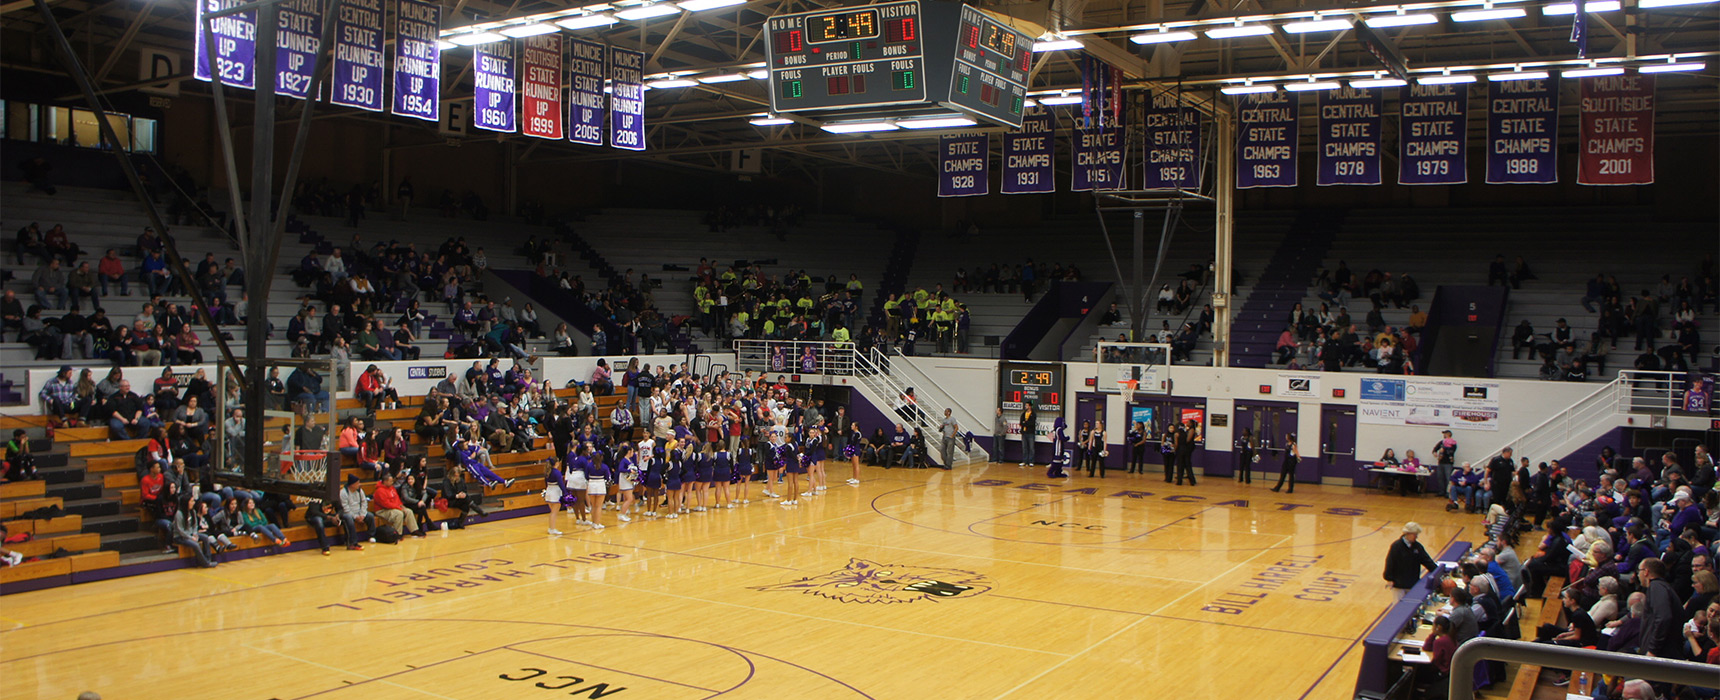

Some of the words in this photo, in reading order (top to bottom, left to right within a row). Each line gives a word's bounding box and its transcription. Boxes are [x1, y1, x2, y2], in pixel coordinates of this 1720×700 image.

[340, 5, 382, 30] CENTRAL
[401, 1, 437, 24] MUNCIE
[880, 4, 917, 20] VISITOR
[963, 8, 981, 26] HOME
[279, 11, 314, 34] STATE
[400, 19, 436, 41] CENTRAL
[772, 17, 802, 31] HOME
[823, 12, 874, 39] 2:49
[902, 18, 914, 41] 0
[344, 25, 377, 48] STATE
[528, 35, 558, 53] MUNCIE
[790, 30, 802, 52] 0
[970, 26, 979, 49] 0
[988, 25, 1015, 55] 2:49
[219, 37, 236, 57] UP
[404, 39, 434, 60] STATE
[574, 43, 602, 62] MUNCIE
[882, 45, 908, 56] BONUS
[289, 52, 304, 71] UP
[337, 43, 383, 68] RUNNER
[525, 49, 559, 69] SOUTHSIDE
[615, 52, 641, 69] MUNCIE
[784, 54, 807, 66] BONUS
[825, 50, 849, 62] PERIOD
[963, 49, 977, 63] BONUS
[1022, 51, 1031, 72] 0
[151, 54, 173, 88] D
[217, 57, 245, 81] 923
[397, 56, 438, 79] RUNNER
[481, 58, 507, 75] STATE
[572, 59, 602, 78] CENTRAL
[822, 66, 848, 77] PLAYER
[852, 63, 874, 74] FOULS
[890, 59, 915, 70] FOULS
[958, 63, 971, 76] FOULS
[279, 71, 312, 93] 1927
[352, 65, 367, 83] UP
[529, 67, 555, 84] STATE
[613, 67, 642, 85] CENTRAL
[780, 70, 802, 80] FOULS
[903, 71, 914, 89] 0
[980, 72, 994, 85] PLAYER
[994, 78, 1007, 90] FOULS
[411, 77, 423, 94] UP
[475, 72, 513, 94] RUNNER
[575, 77, 599, 93] STATE
[792, 81, 802, 98] 0
[962, 76, 969, 94] 0
[1012, 85, 1024, 97] FOULS
[1410, 83, 1456, 97] MUNCIE
[1500, 80, 1547, 94] MUNCIE
[1593, 75, 1642, 92] MUNCIE
[343, 84, 374, 105] 1930
[526, 82, 559, 102] RUNNER
[615, 83, 639, 100] STATE
[1329, 86, 1371, 100] MUNCIE
[403, 94, 432, 115] 1954
[488, 93, 501, 108] UP
[572, 91, 604, 109] RUNNER
[1015, 98, 1022, 113] 0
[1492, 97, 1555, 114] CENTRAL
[1581, 95, 1653, 113] SOUTHSIDE
[536, 102, 549, 116] UP
[582, 109, 593, 123] UP
[1242, 108, 1294, 123] CENTRAL
[1322, 105, 1379, 119] CENTRAL
[1403, 101, 1462, 117] CENTRAL
[448, 104, 462, 132] E
[482, 108, 506, 127] 1960
[622, 115, 634, 129] UP
[1594, 117, 1638, 133] STATE
[530, 117, 554, 135] 1999
[575, 124, 600, 140] 2005
[1331, 123, 1371, 138] STATE
[1411, 121, 1454, 136] STATE
[1501, 118, 1546, 134] STATE
[616, 130, 638, 146] 2006
[1081, 132, 1116, 148] STATE
[1154, 130, 1193, 145] STATE
[1249, 128, 1286, 142] STATE
[948, 142, 979, 155] STATE
[1012, 137, 1046, 151] STATE
[1325, 142, 1376, 157] CHAMPS
[1406, 140, 1459, 156] CHAMPS
[1494, 138, 1550, 154] CHAMPS
[1587, 138, 1644, 154] CHAMPS
[1008, 154, 1050, 168] CHAMPS
[1243, 146, 1290, 160] CHAMPS
[944, 158, 983, 173] CHAMPS
[1253, 164, 1281, 179] 1963
[1335, 161, 1365, 176] 1978
[1416, 160, 1449, 175] 1979
[1506, 159, 1539, 174] 1988
[1599, 158, 1632, 175] 2001
[952, 175, 974, 189] 1928
[1017, 171, 1039, 186] 1931
[1159, 167, 1186, 182] 1952
[1082, 295, 1089, 303] 4
[1469, 302, 1477, 311] 5
[1020, 371, 1050, 385] 2:49
[1014, 391, 1021, 402] 0
[1051, 392, 1058, 404] 0
[1691, 398, 1704, 408] 34
[1362, 408, 1400, 417] NAVIENT
[1453, 410, 1497, 419] FIREHOUSE
[970, 479, 1369, 517] BEARCATS
[1031, 520, 1108, 531] NCC
[530, 551, 623, 569] BILL
[374, 558, 514, 588] COURT
[317, 569, 535, 611] HARRELL
[1200, 592, 1268, 615] BILL
[1240, 554, 1325, 591] HARRELL
[1293, 571, 1361, 602] COURT
[499, 668, 628, 700] NCC
